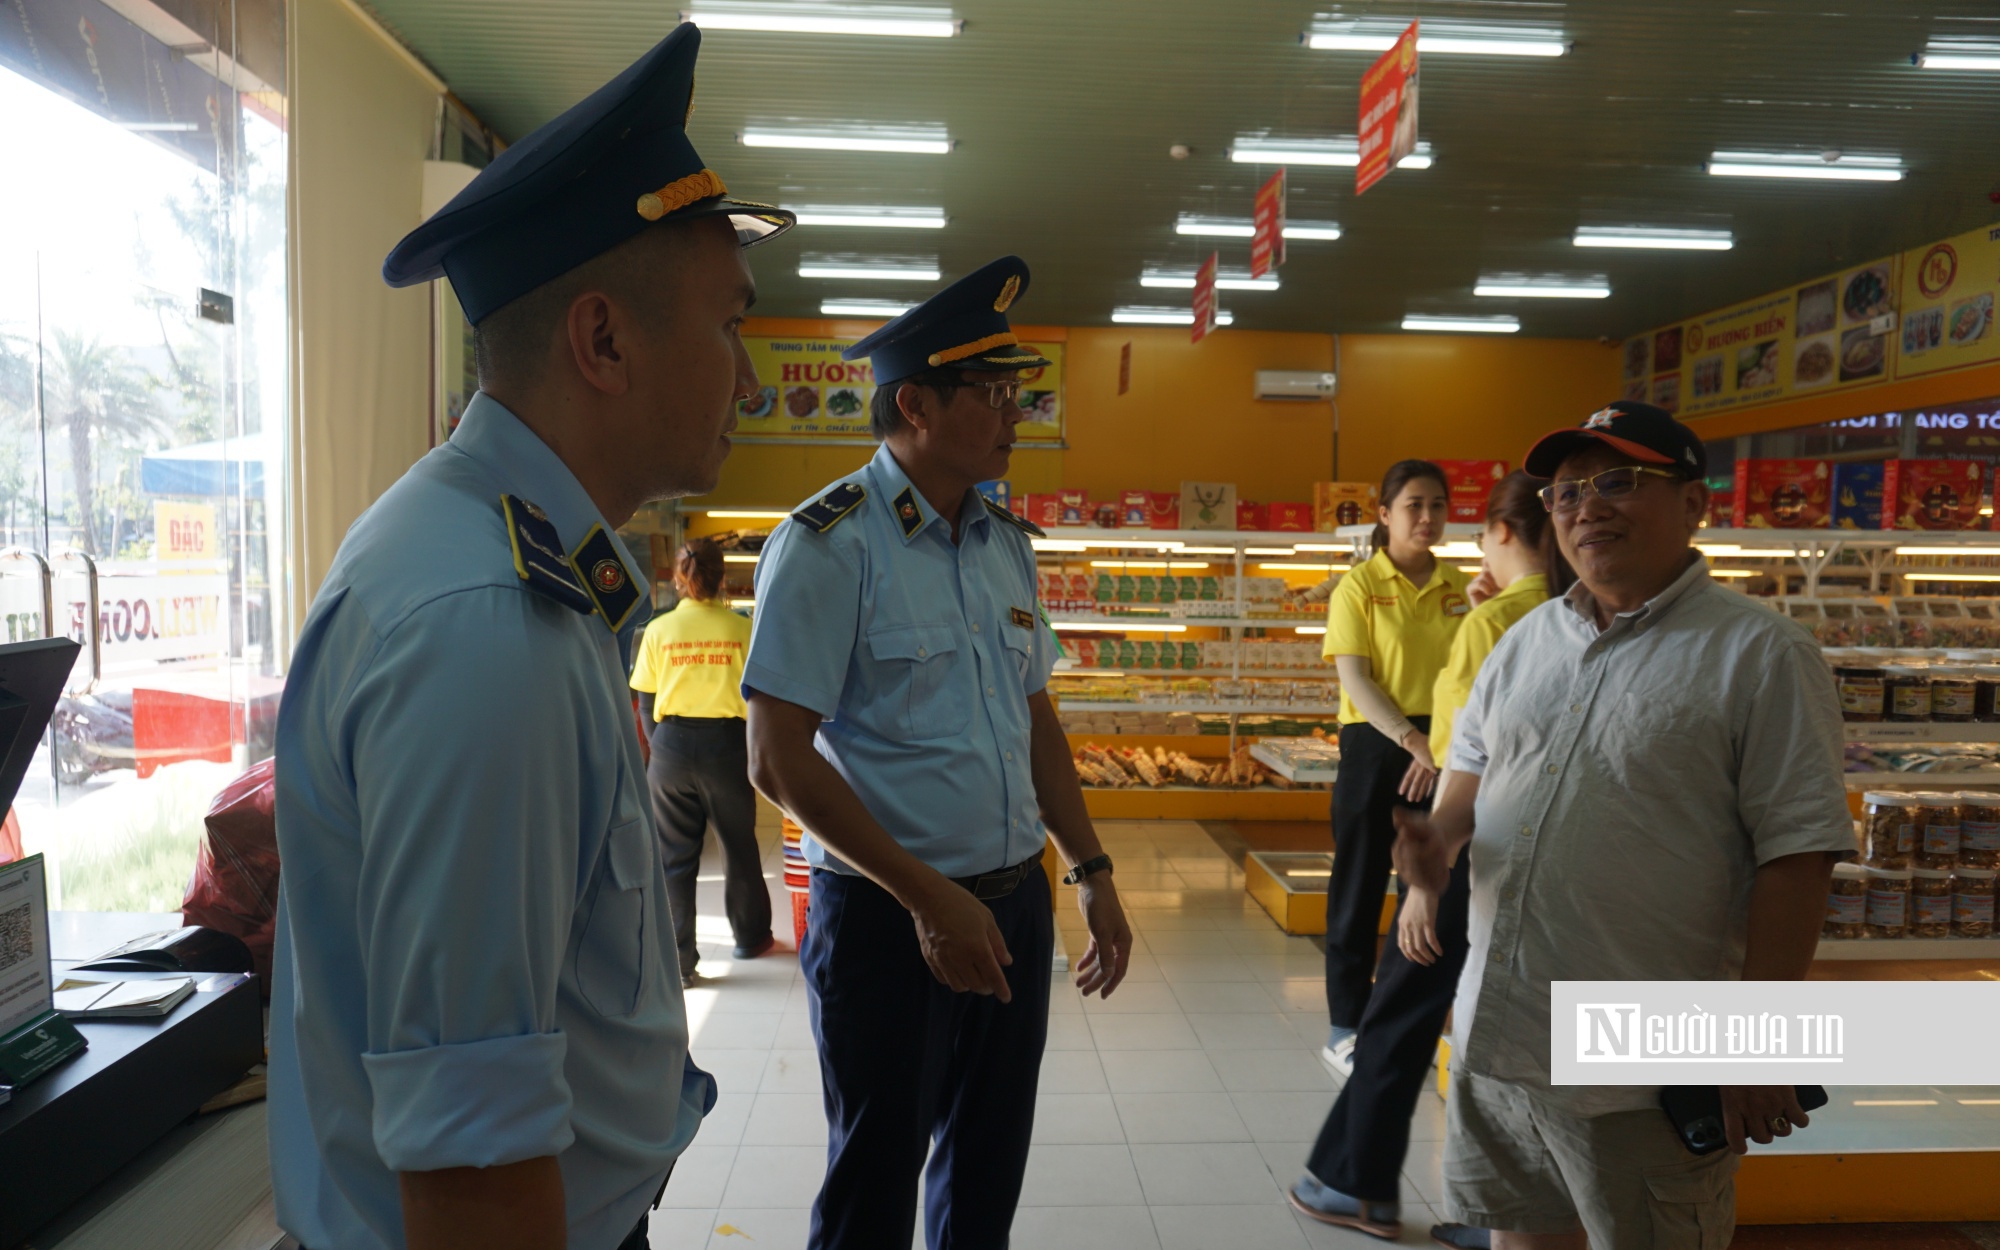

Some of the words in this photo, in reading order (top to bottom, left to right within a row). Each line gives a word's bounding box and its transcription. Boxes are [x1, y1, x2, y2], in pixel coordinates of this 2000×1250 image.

[770, 342, 803, 352] TRUNG
[806, 341, 827, 352] TÂM
[781, 361, 875, 383] HƯƠN
[1884, 412, 1969, 429] TANG
